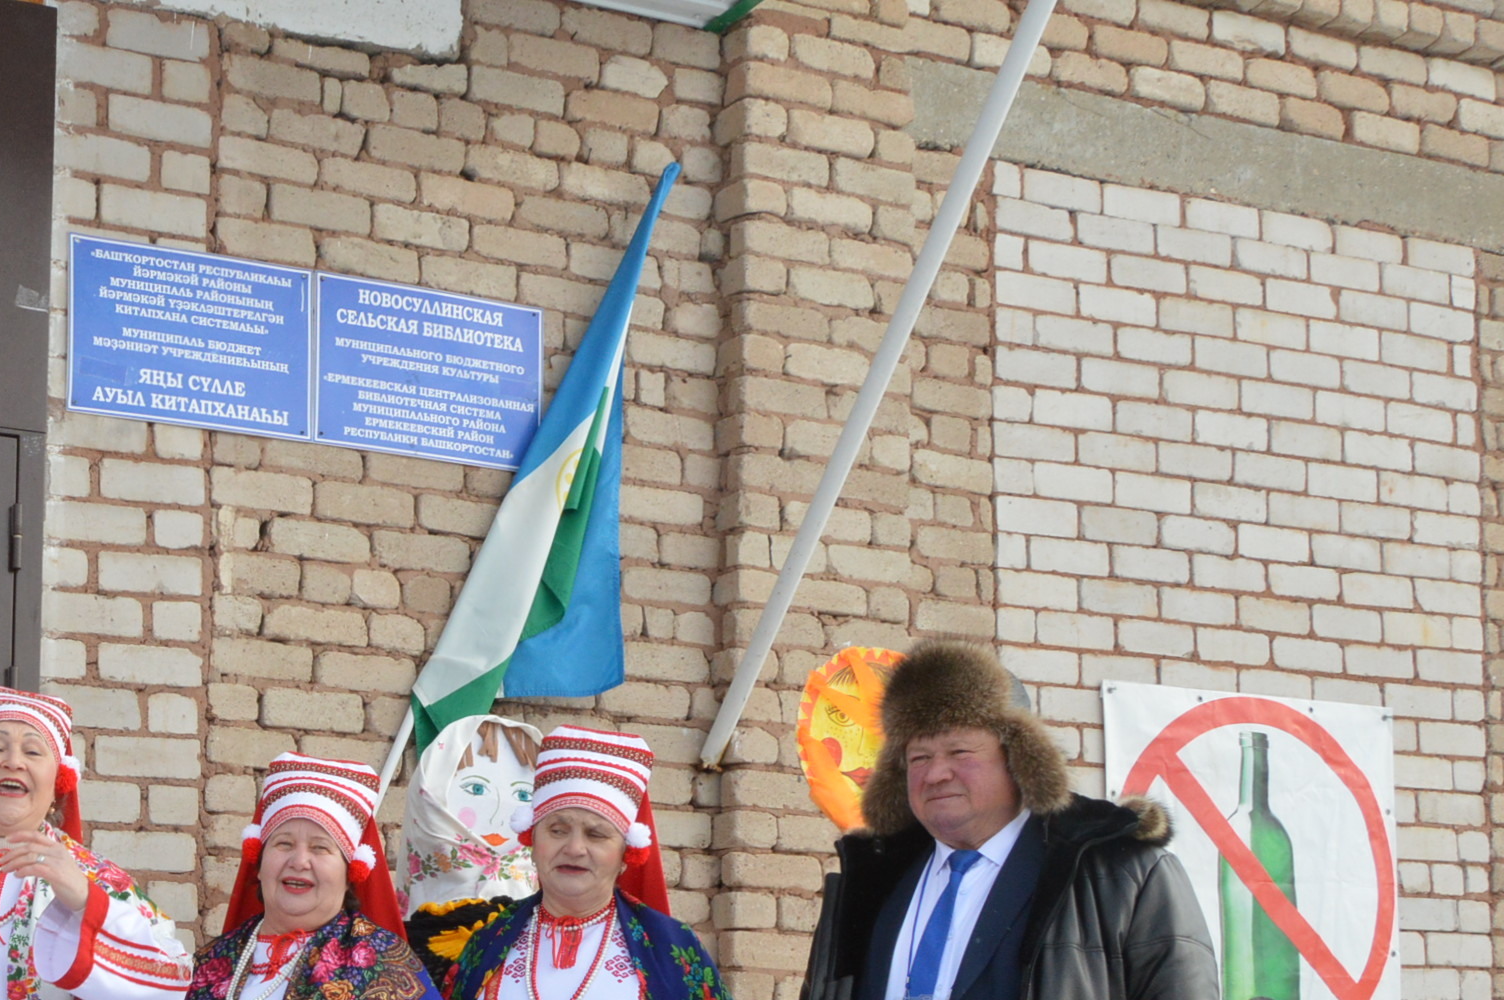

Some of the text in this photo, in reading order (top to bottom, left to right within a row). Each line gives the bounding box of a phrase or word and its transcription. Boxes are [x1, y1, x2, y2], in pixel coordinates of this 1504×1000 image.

[110, 277, 193, 298] МУНИЦИПАЛЬ
[202, 276, 252, 294] РАЙОНЫ
[115, 304, 188, 323] КИТАПХАНА
[358, 289, 503, 327] НОВОСУЛЛИНСКАЯ
[122, 327, 262, 356] МУНИЦИПАЛЬ БЮДЖЕТ
[337, 308, 523, 352] СЕЛЬСКАЯ БИБЛИОТЕКА
[335, 337, 525, 375] МУНИЦИПАЛЬНОГО БЮДЖЕТНОГО
[361, 354, 499, 384] УЧРЕЖДЕНИЯ КУЛЬТУРЫ
[139, 369, 182, 389] ЯҢЫ
[92, 386, 145, 407] АУЫЛ
[358, 390, 501, 420] БИБЛИОТЕЧНАЯ СИСТЕМА
[419, 386, 534, 413] ЦЕНТРАЛИЗОВАННАЯ
[353, 403, 506, 433] МУНИЦИПАЛЬНОГО РАЙОНА
[365, 417, 494, 444] ЕРМЕКЕЕВСКИЙ РАЙОН
[344, 427, 418, 445] РЕСПУБЛИКИ
